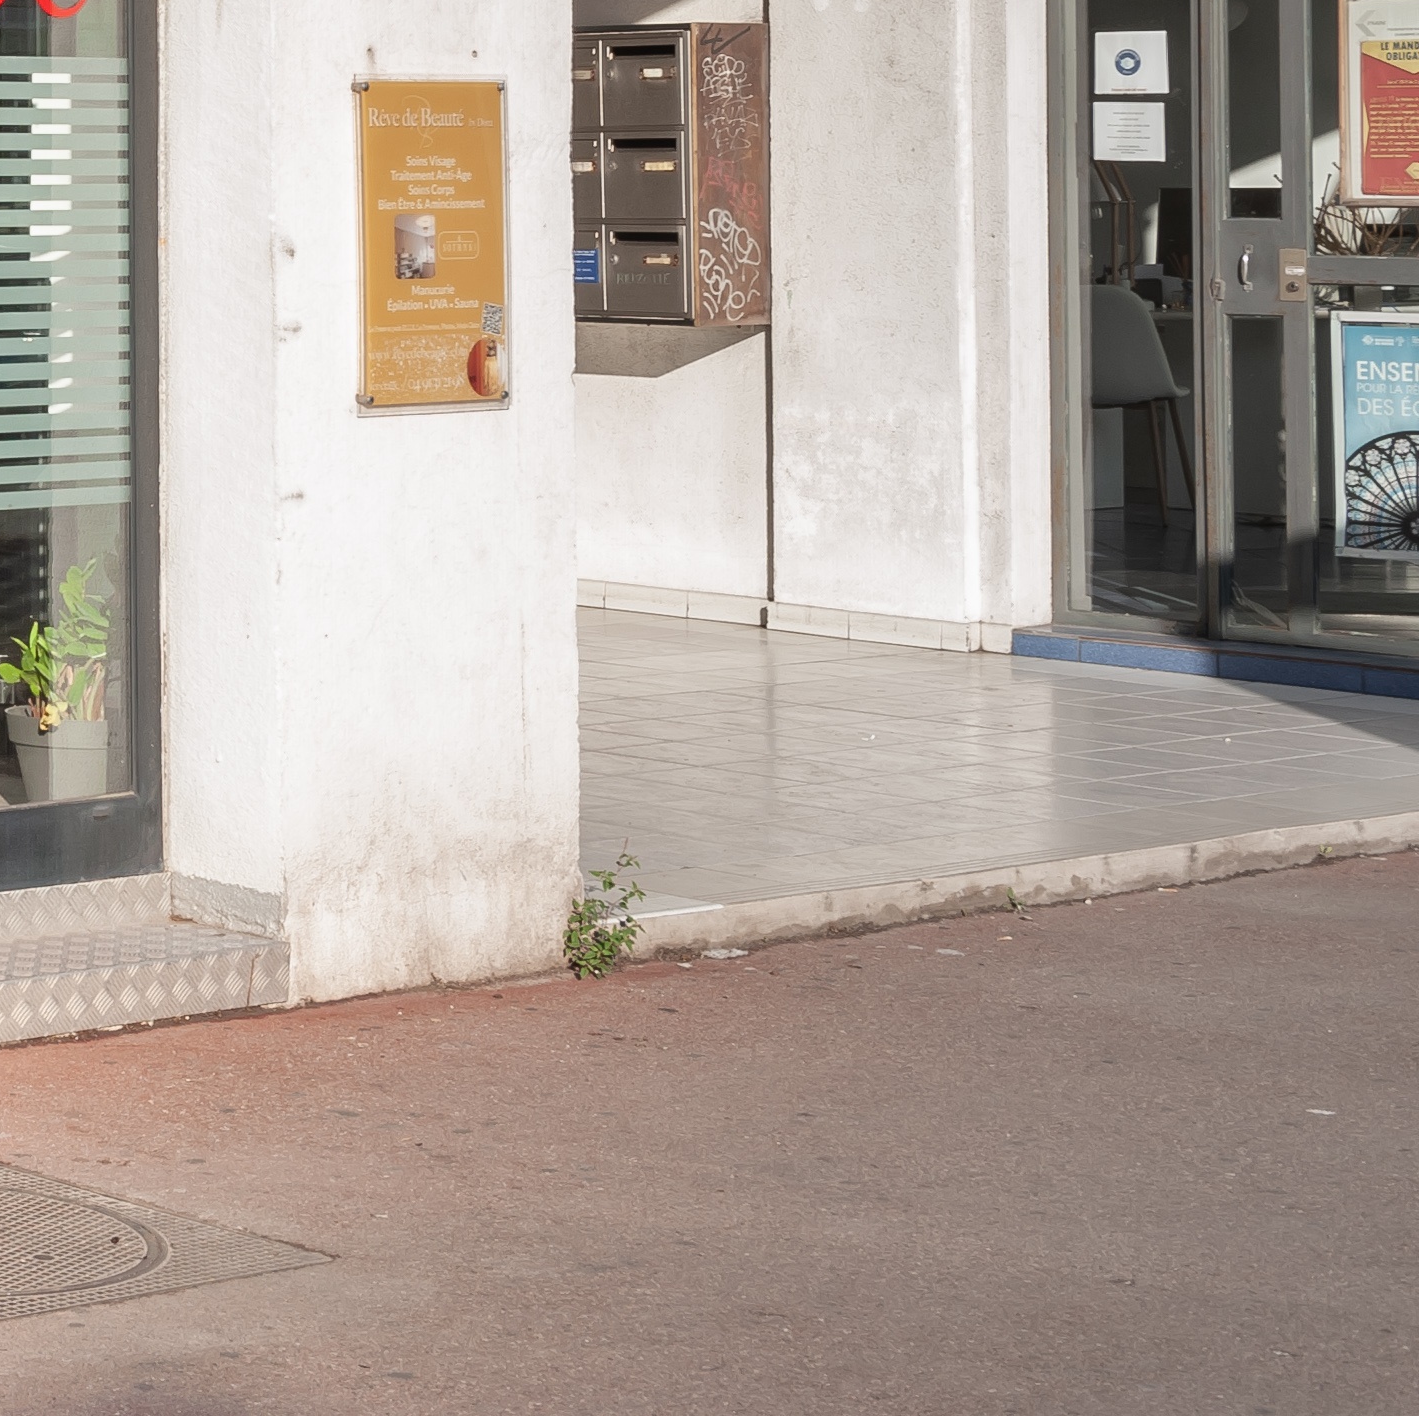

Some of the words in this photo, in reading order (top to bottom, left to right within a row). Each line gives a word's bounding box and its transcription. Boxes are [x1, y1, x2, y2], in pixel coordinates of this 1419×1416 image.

[1386, 51, 1419, 61] OBLIGA
[402, 108, 417, 127] de
[420, 107, 465, 128] Beauté
[405, 155, 428, 167] Soins
[429, 155, 457, 169] Visage
[390, 170, 434, 181] Traitement
[408, 184, 430, 195] Soins
[431, 184, 455, 197] Corps
[378, 199, 397, 210] Bien
[454, 298, 479, 309] Sauna
[1357, 382, 1386, 394] POUR
[1389, 384, 1403, 394] LA
[1357, 397, 1394, 416] DES
